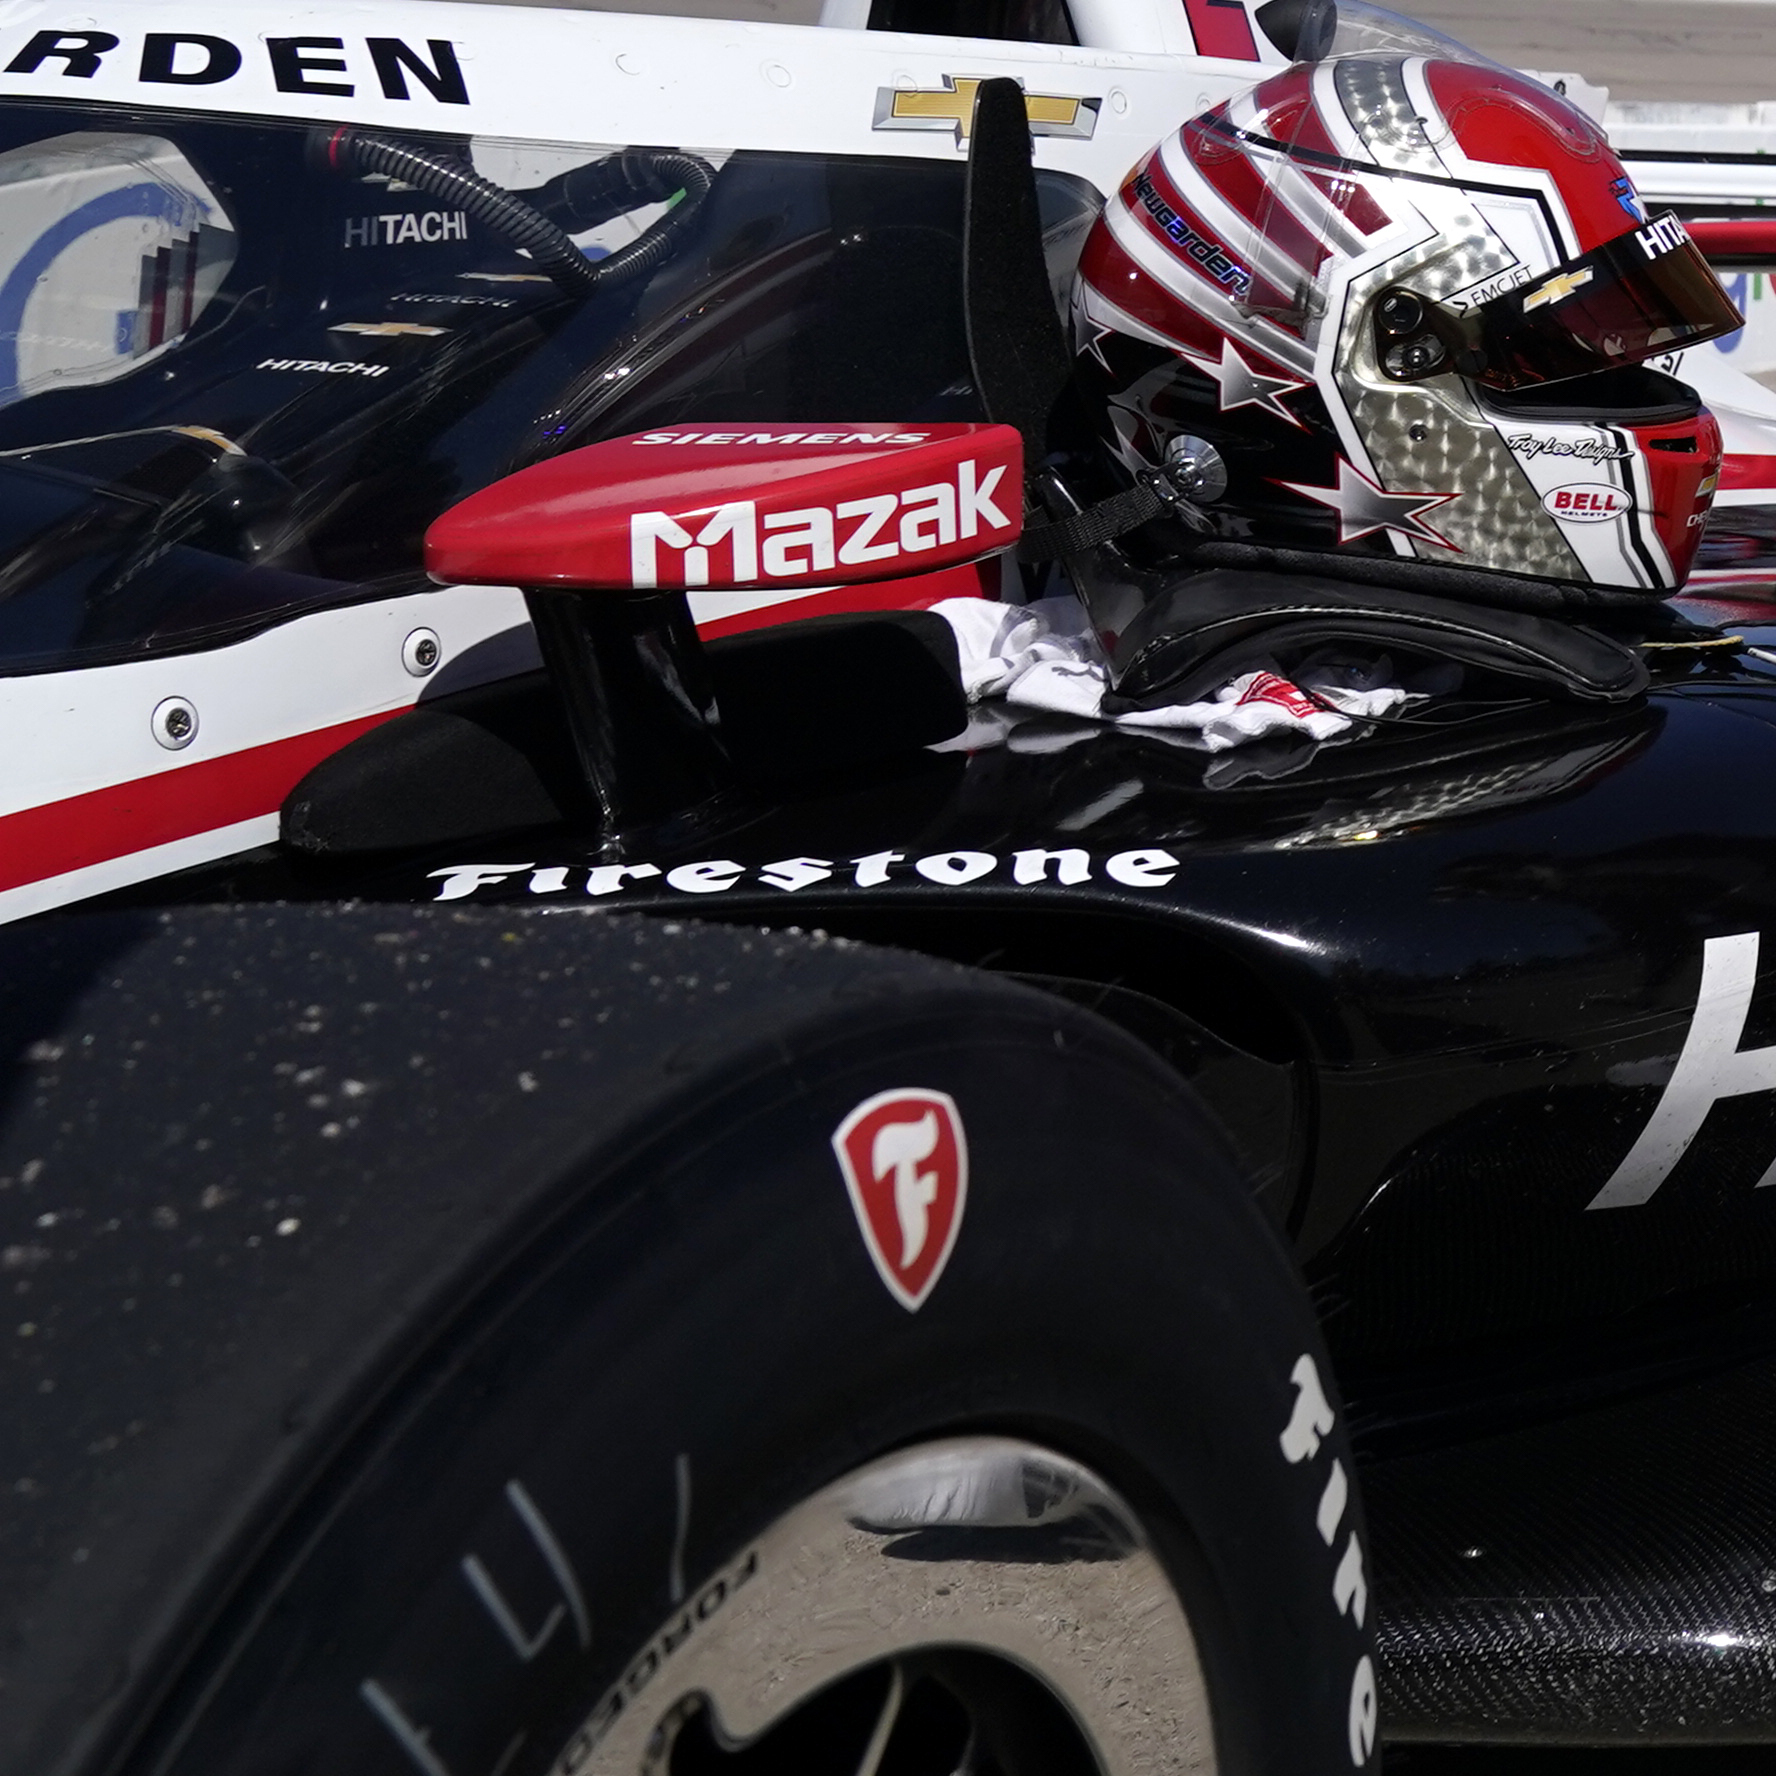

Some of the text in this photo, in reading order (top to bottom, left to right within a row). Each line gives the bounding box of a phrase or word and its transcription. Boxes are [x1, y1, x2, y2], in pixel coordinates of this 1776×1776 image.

[344, 210, 468, 249] HITACHI
[254, 357, 392, 379] HITACHI
[631, 432, 931, 446] SIEMENS
[1554, 491, 1618, 512] BELL
[630, 458, 1012, 589] Mazak
[426, 846, 1182, 902] Firestone
